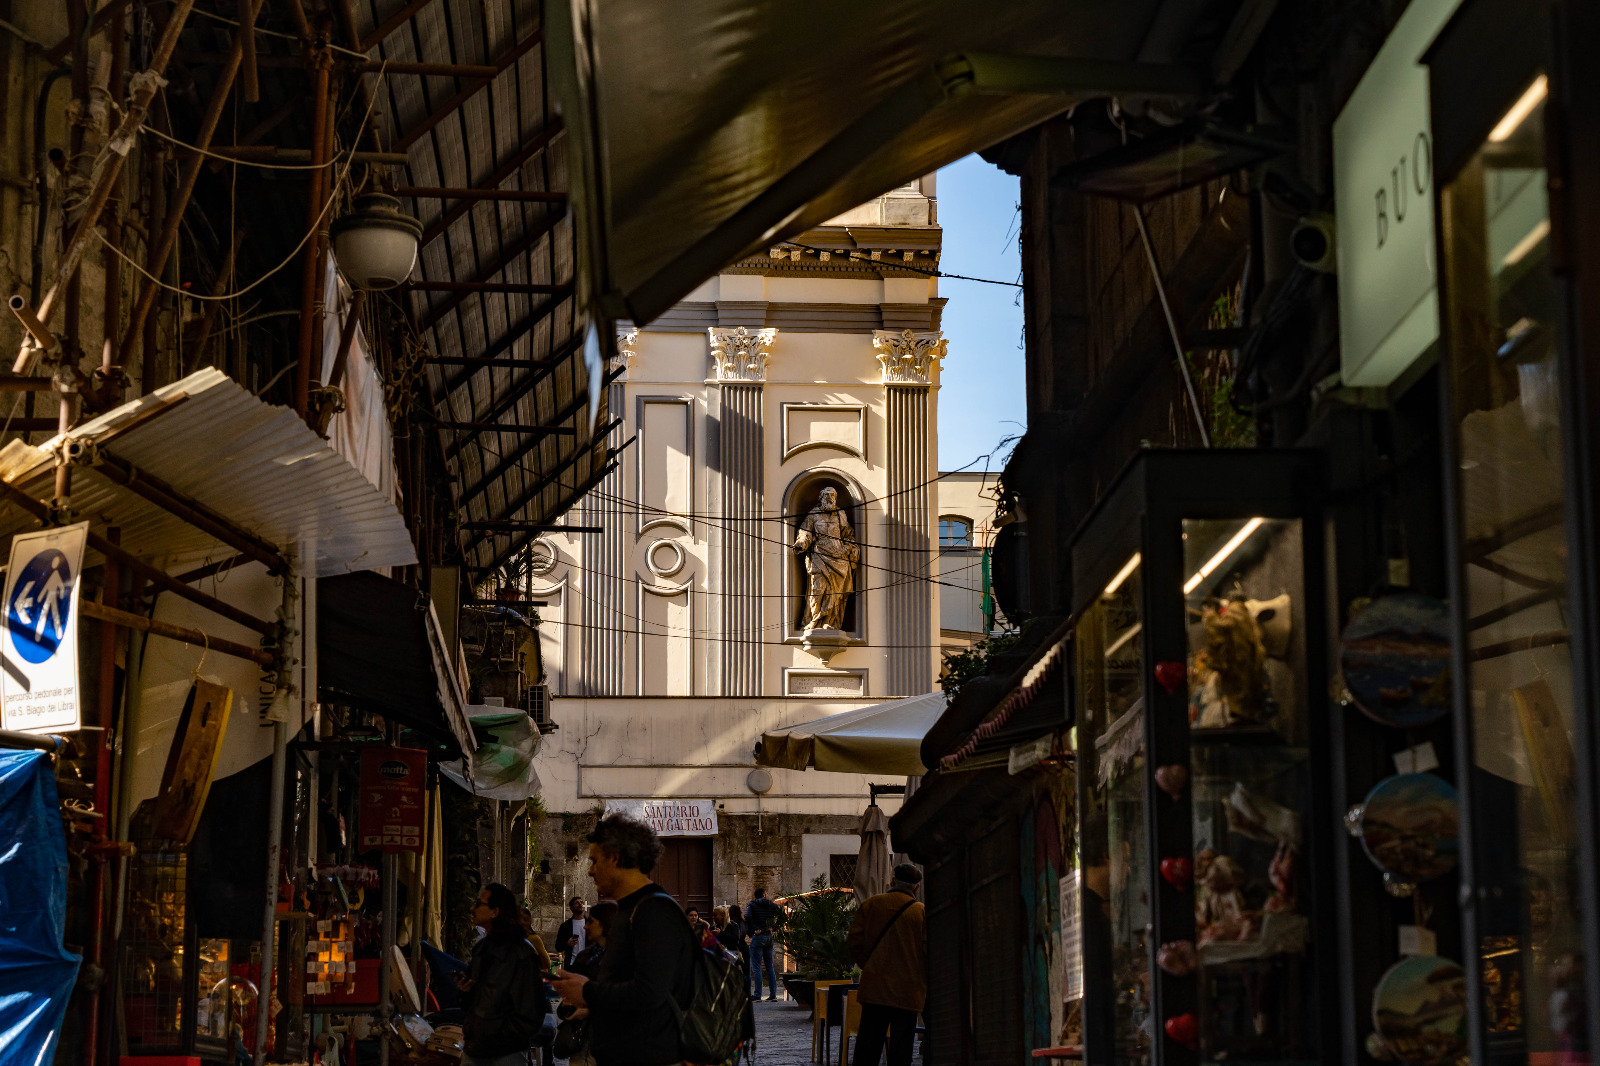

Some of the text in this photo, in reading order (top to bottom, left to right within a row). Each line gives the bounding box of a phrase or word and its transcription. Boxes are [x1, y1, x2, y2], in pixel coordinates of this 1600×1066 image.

[5, 687, 74, 703] percorso pedonale per
[7, 709, 16, 717] via
[26, 705, 45, 716] Biagio
[379, 766, 409, 775] motta
[644, 805, 699, 818] SANTUARIO
[666, 818, 713, 831] GAETANO
